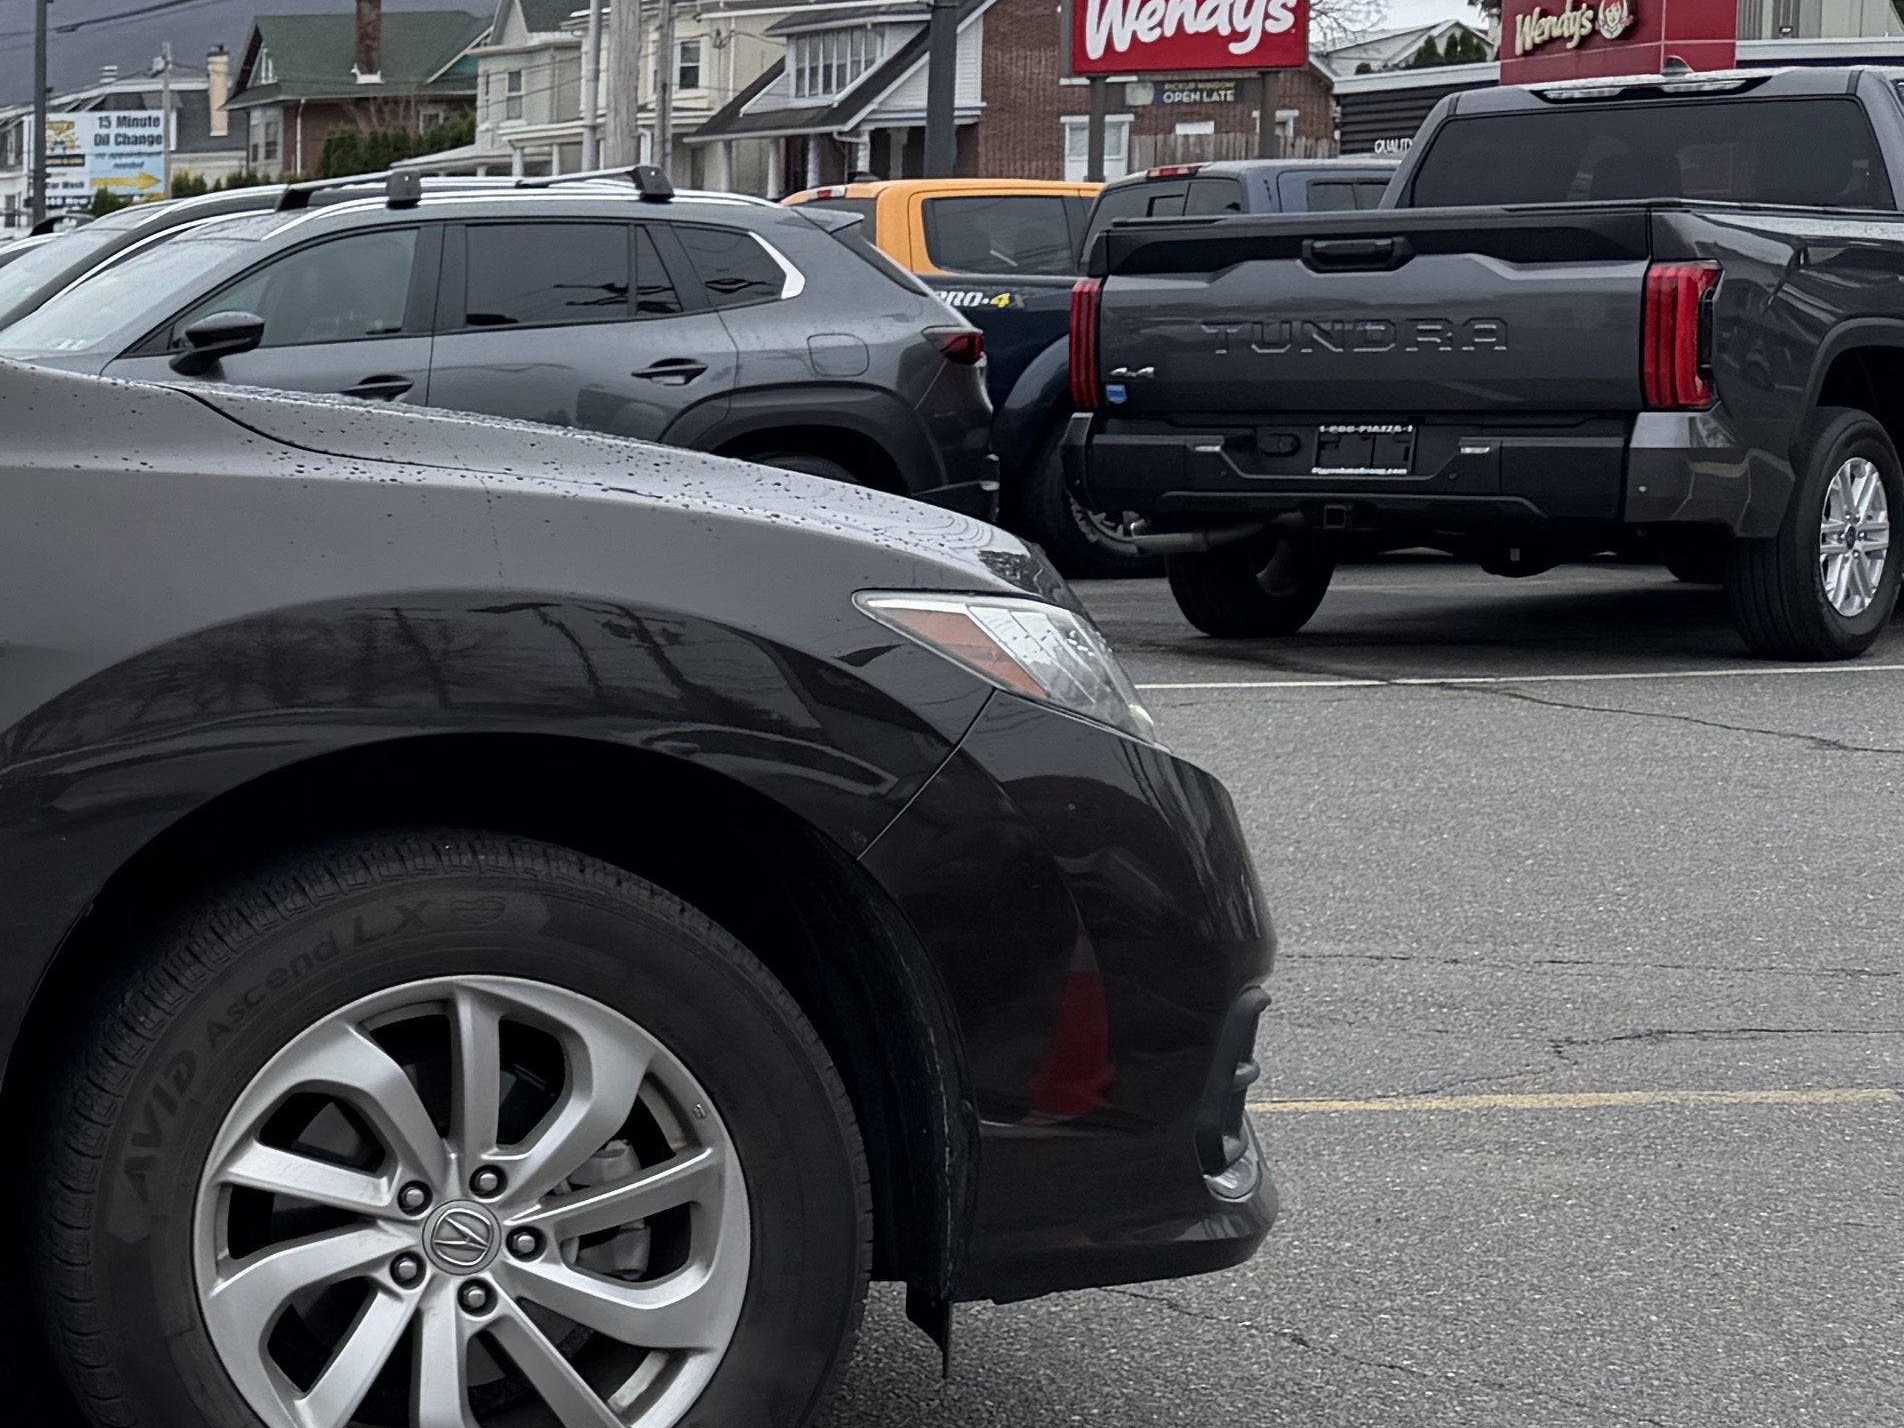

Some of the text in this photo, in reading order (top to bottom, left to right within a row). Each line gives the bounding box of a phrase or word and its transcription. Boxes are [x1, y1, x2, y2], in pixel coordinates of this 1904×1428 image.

[1162, 90, 1235, 104] OPEN LATE
[98, 115, 161, 130] 15 Minute
[94, 133, 163, 147] Oil Change
[1200, 317, 1509, 355] TUNDRA
[122, 1049, 198, 1202] AVID
[203, 927, 341, 1049] Ascend
